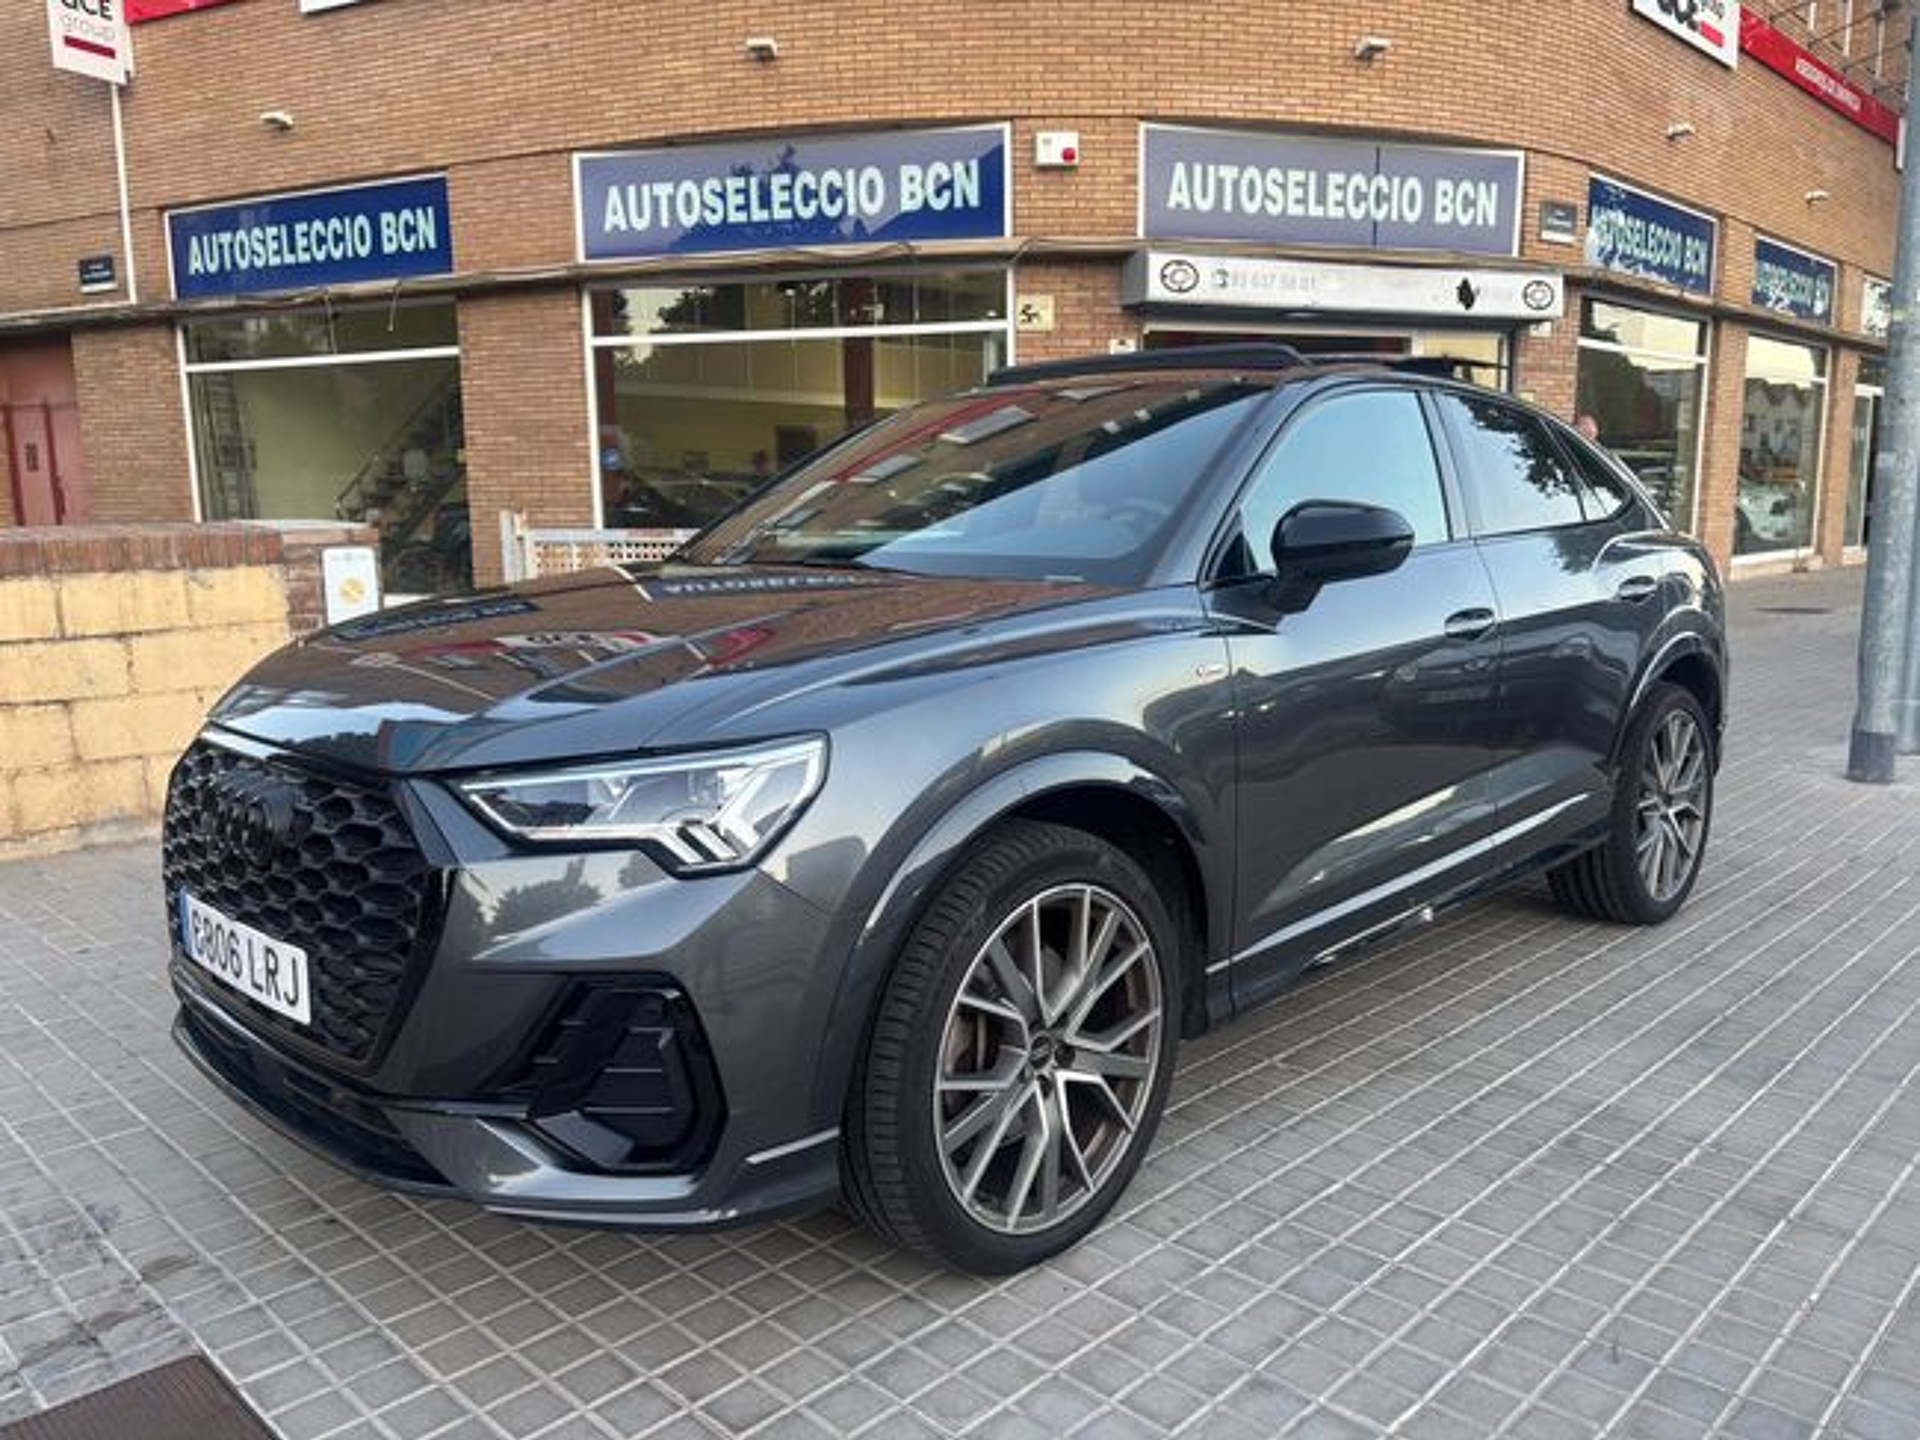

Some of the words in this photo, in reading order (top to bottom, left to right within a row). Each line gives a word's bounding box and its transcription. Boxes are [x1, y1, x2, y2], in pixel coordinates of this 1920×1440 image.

[604, 165, 885, 232] AUTOSELECCIO
[900, 159, 979, 212] BCN
[1167, 161, 1423, 223] AUTOSELECCIO
[1434, 178, 1498, 227] BCN
[188, 213, 372, 275] AUTOSELECCIO
[380, 206, 437, 254] BCN
[247, 937, 299, 1007] LRJ
